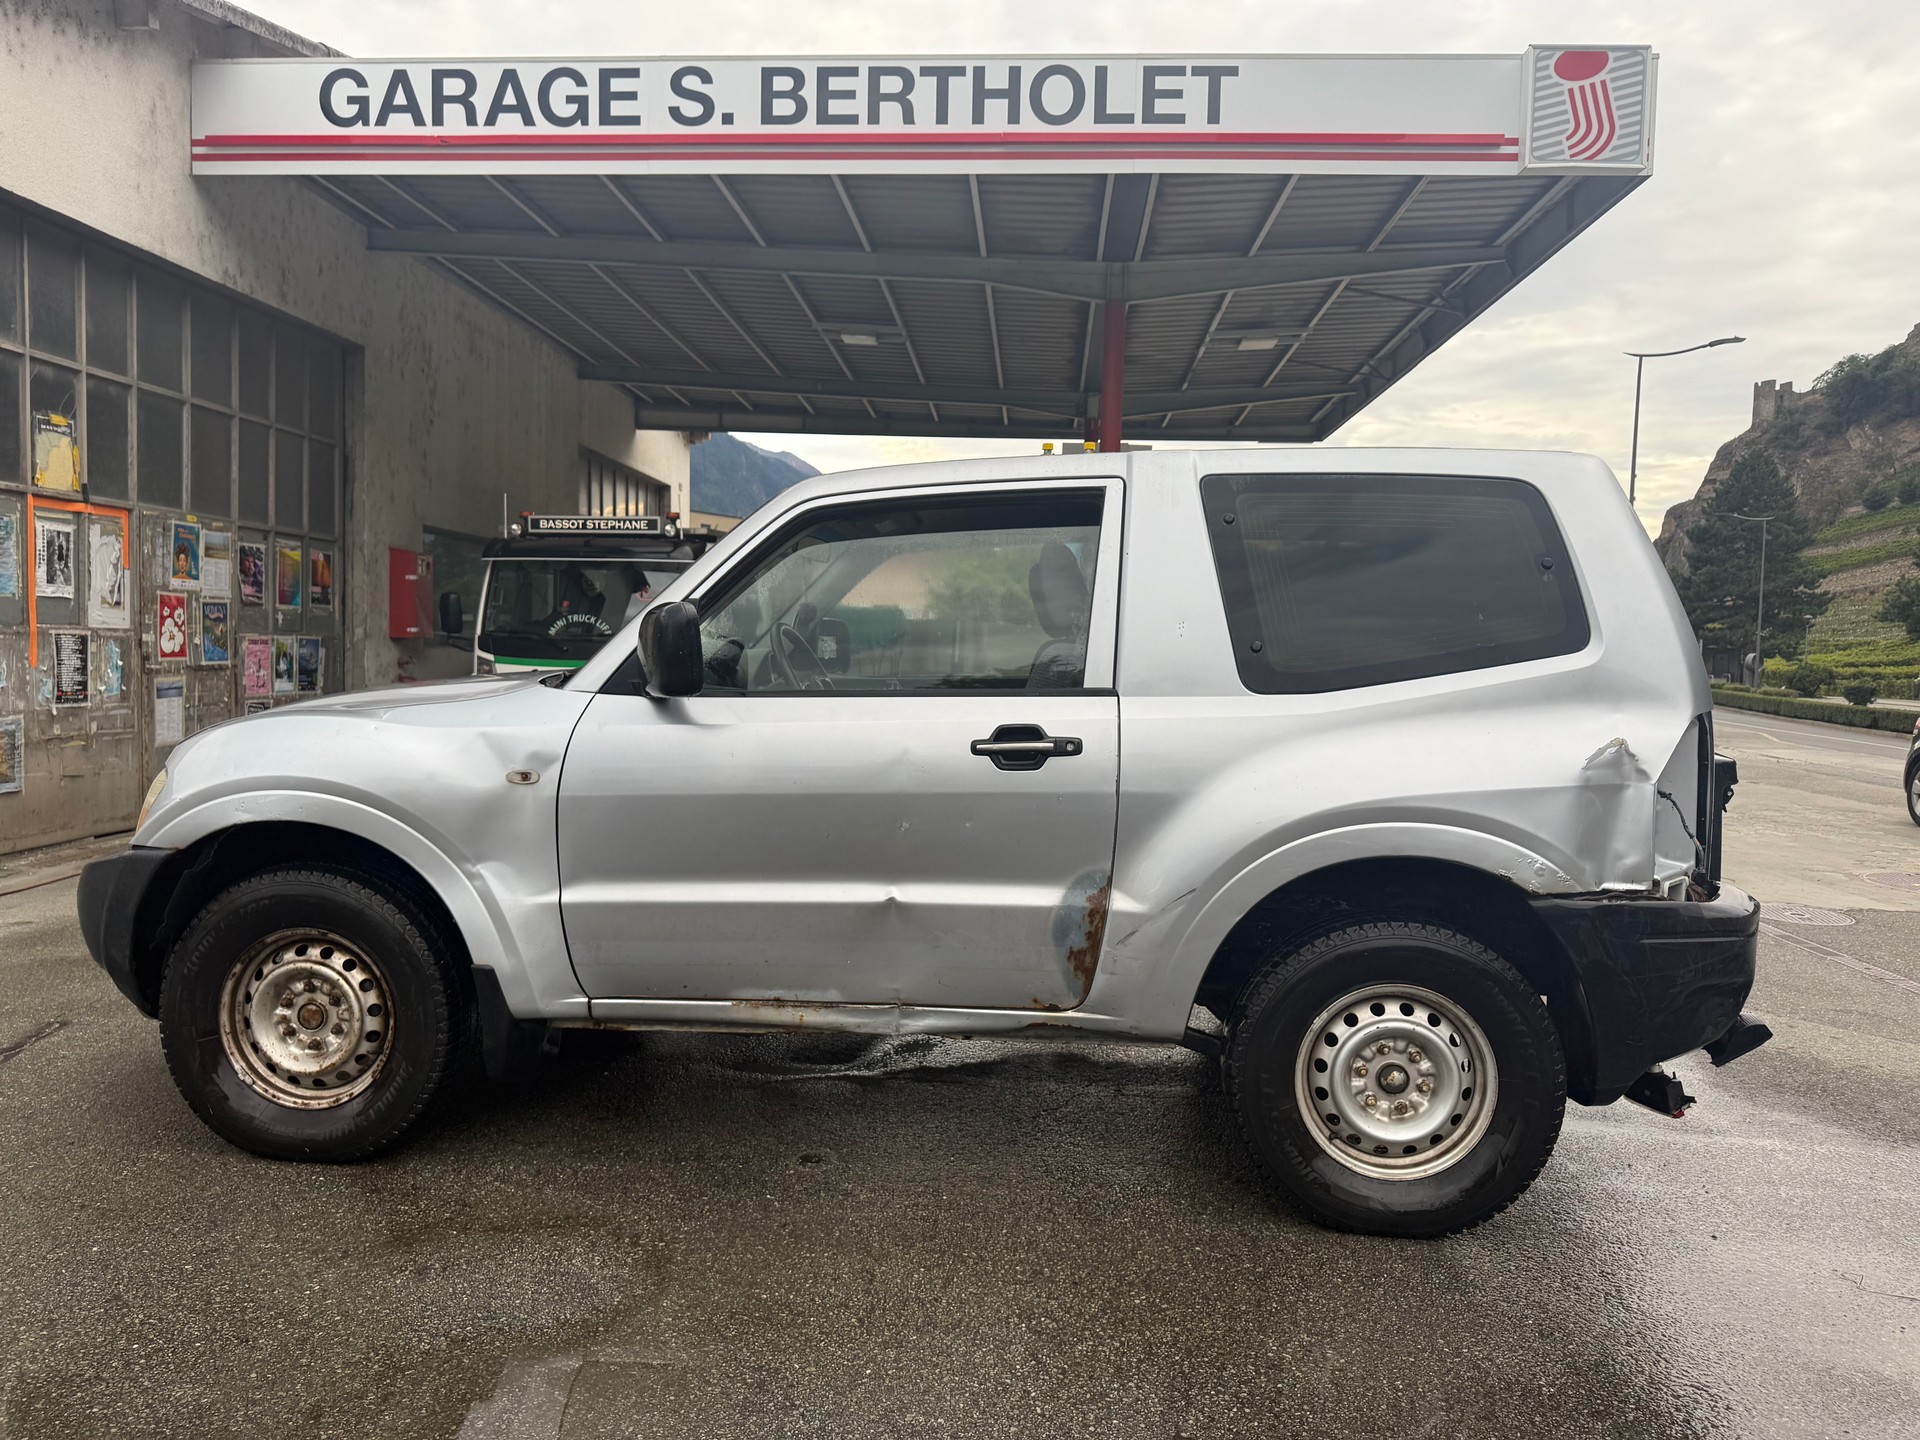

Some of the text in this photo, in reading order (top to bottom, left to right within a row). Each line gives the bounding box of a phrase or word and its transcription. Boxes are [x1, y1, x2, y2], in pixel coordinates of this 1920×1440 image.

[319, 64, 1239, 128] GARAGE S. BERTHOLET
[540, 519, 648, 529] BASSOT STEPHANE
[548, 617, 567, 636] MINI
[567, 614, 597, 624] TRUCK
